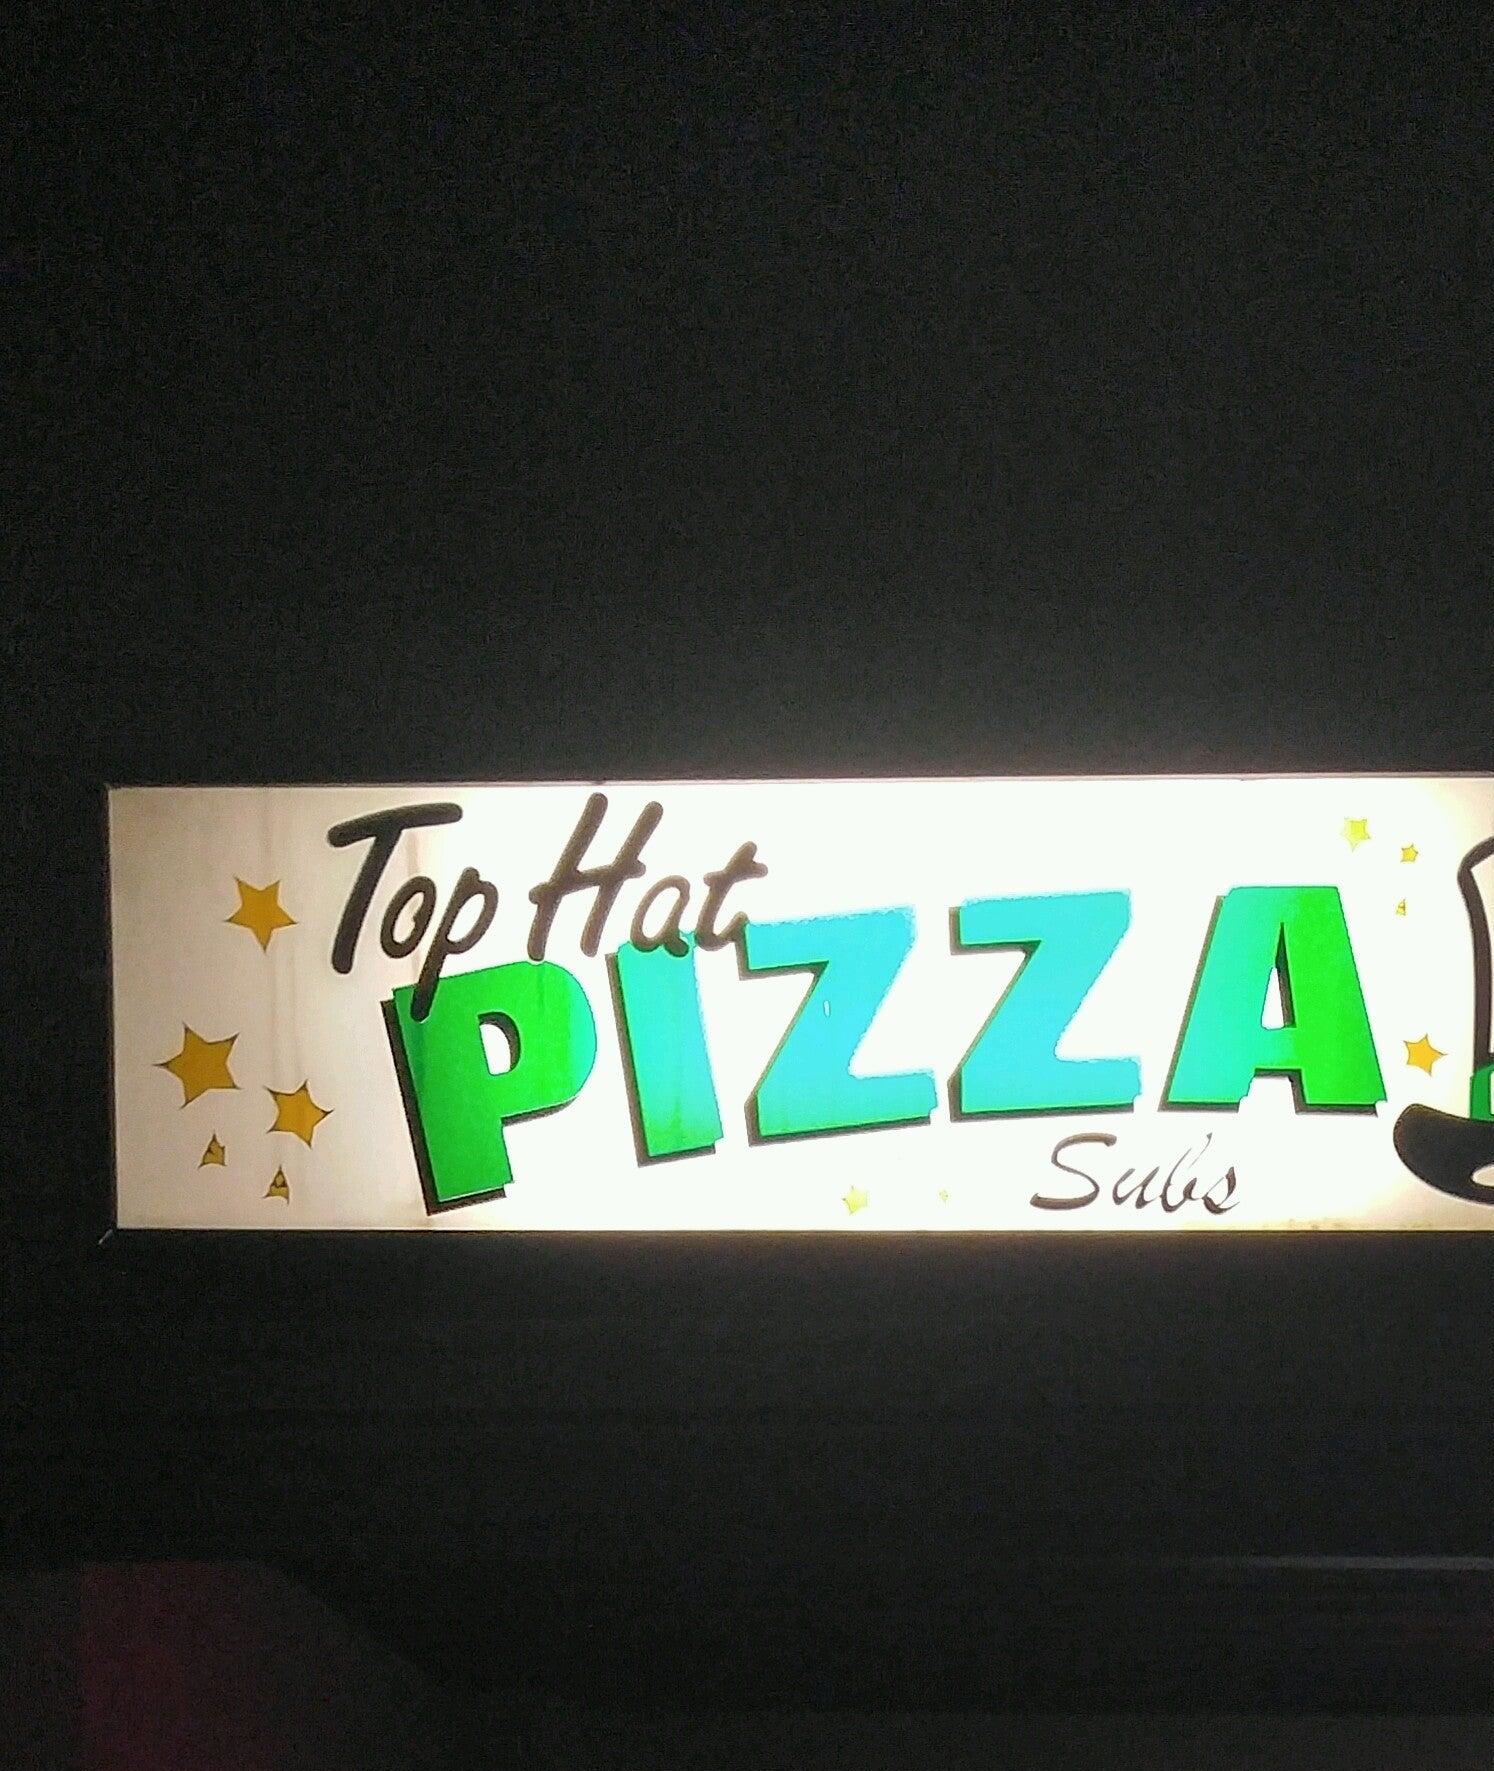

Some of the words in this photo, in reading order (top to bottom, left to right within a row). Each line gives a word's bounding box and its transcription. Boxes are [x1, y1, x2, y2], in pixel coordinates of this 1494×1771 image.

[327, 802, 499, 1020] Top
[527, 792, 769, 962] Hat
[380, 886, 1389, 1215] PIZZA
[1028, 1130, 1240, 1215] Subs
